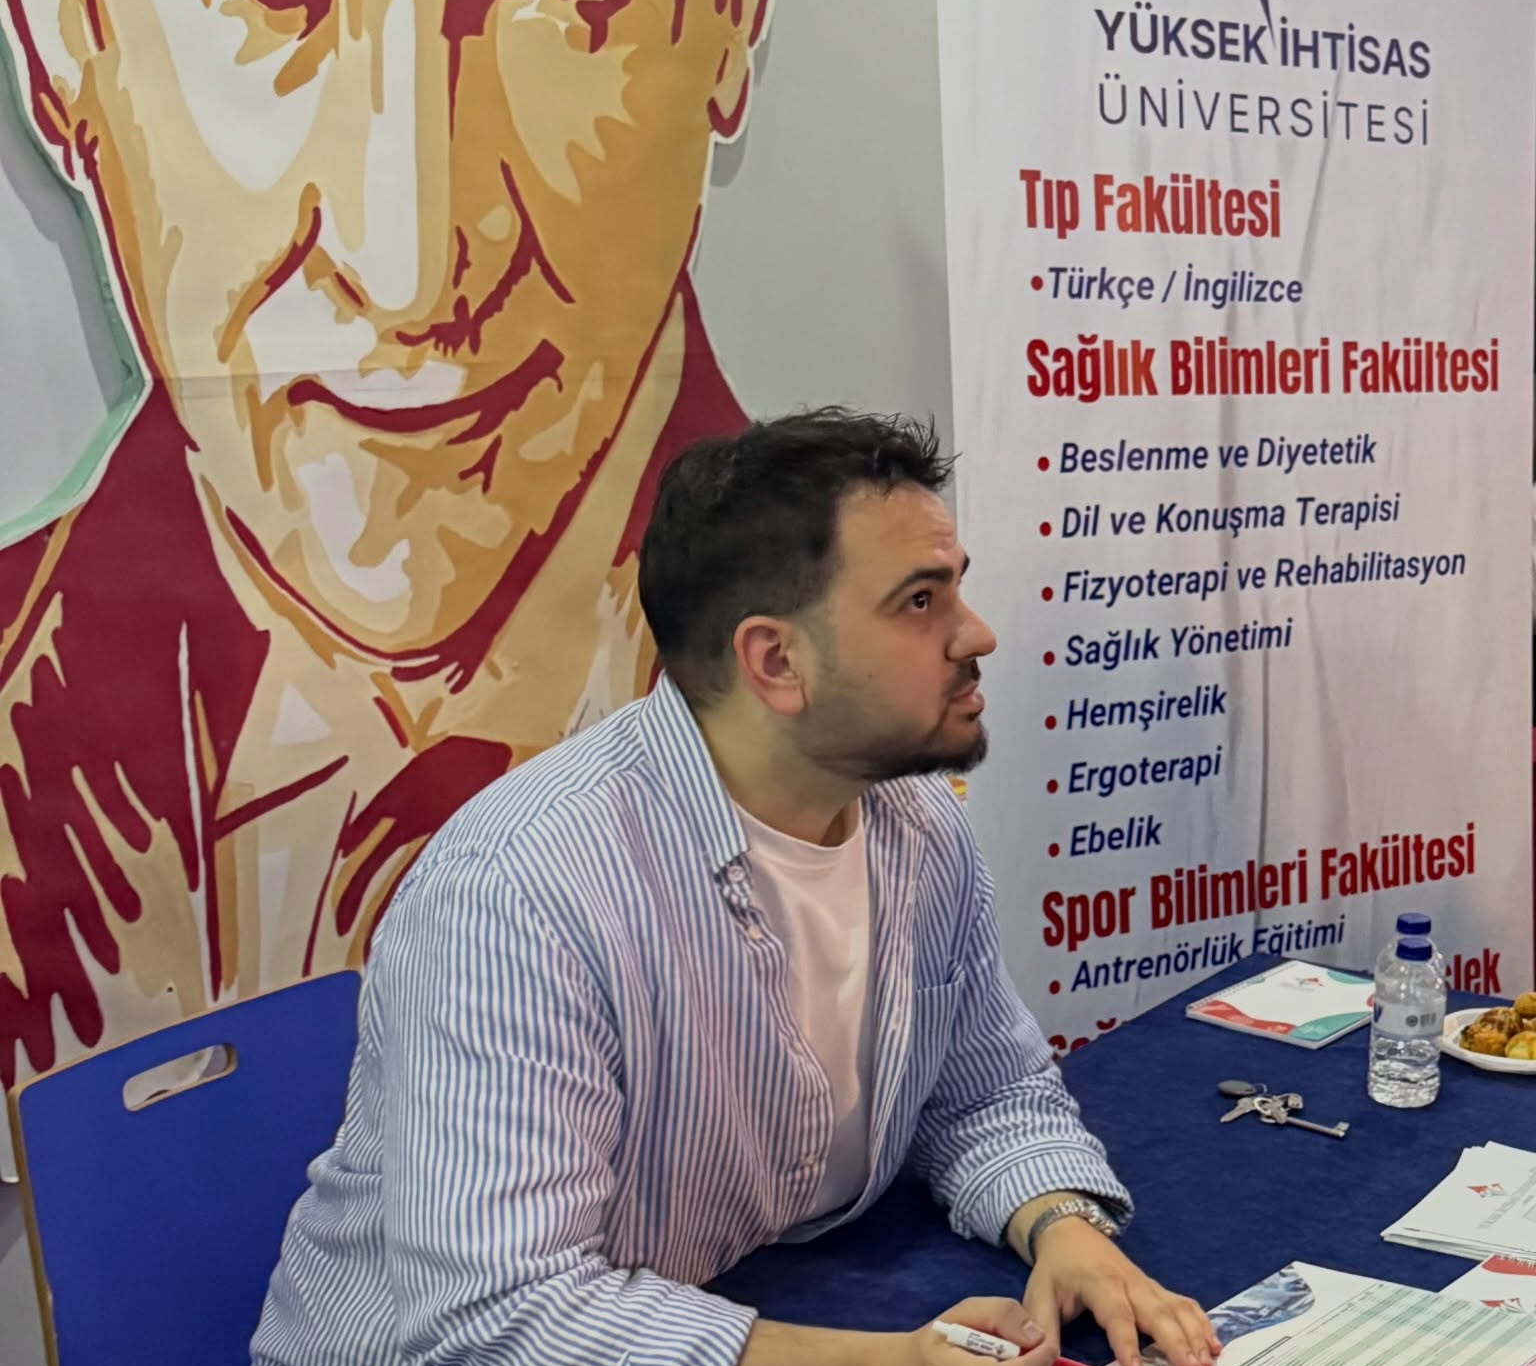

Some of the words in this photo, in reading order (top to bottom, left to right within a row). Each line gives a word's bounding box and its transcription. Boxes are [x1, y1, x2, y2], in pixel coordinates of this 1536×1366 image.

[1094, 1, 1269, 65] YÜKSEK
[1280, 16, 1431, 79] İHTİSAS
[1099, 70, 1431, 146] ÜNİVERSİTESİ
[1019, 169, 1080, 240] Tıp
[1093, 173, 1281, 238] Fakültesi
[1048, 266, 1155, 309] Türkçe
[1184, 263, 1303, 310] İngilizce
[1026, 334, 1158, 404] Sağlık
[1170, 336, 1330, 396] Bilimleri
[1342, 337, 1499, 394] Fakültesi
[1060, 439, 1209, 474] Beslenme
[1218, 445, 1249, 469] ve
[1257, 433, 1377, 474] Diyetetik
[1061, 504, 1100, 539] Dil
[1110, 511, 1146, 536] ve
[1156, 502, 1286, 539] Konuşma
[1296, 492, 1401, 531] Terapisi
[1063, 560, 1229, 608] Fizyoterapi
[1237, 566, 1266, 590] ve
[1274, 551, 1466, 588] Rehabilitasyon
[1065, 630, 1160, 671] Sağlık
[1171, 617, 1293, 658] Yönetimi
[1066, 684, 1227, 732] Hemşirelik
[1068, 745, 1222, 798] Ergoterapi
[1070, 814, 1162, 857] Ebelik
[1042, 886, 1136, 953] Spor
[1150, 848, 1308, 929] Bilimleri
[1320, 822, 1476, 898] Fakültesi
[1070, 934, 1245, 993] Antrenörlük
[1250, 915, 1346, 956] Eğitimi
